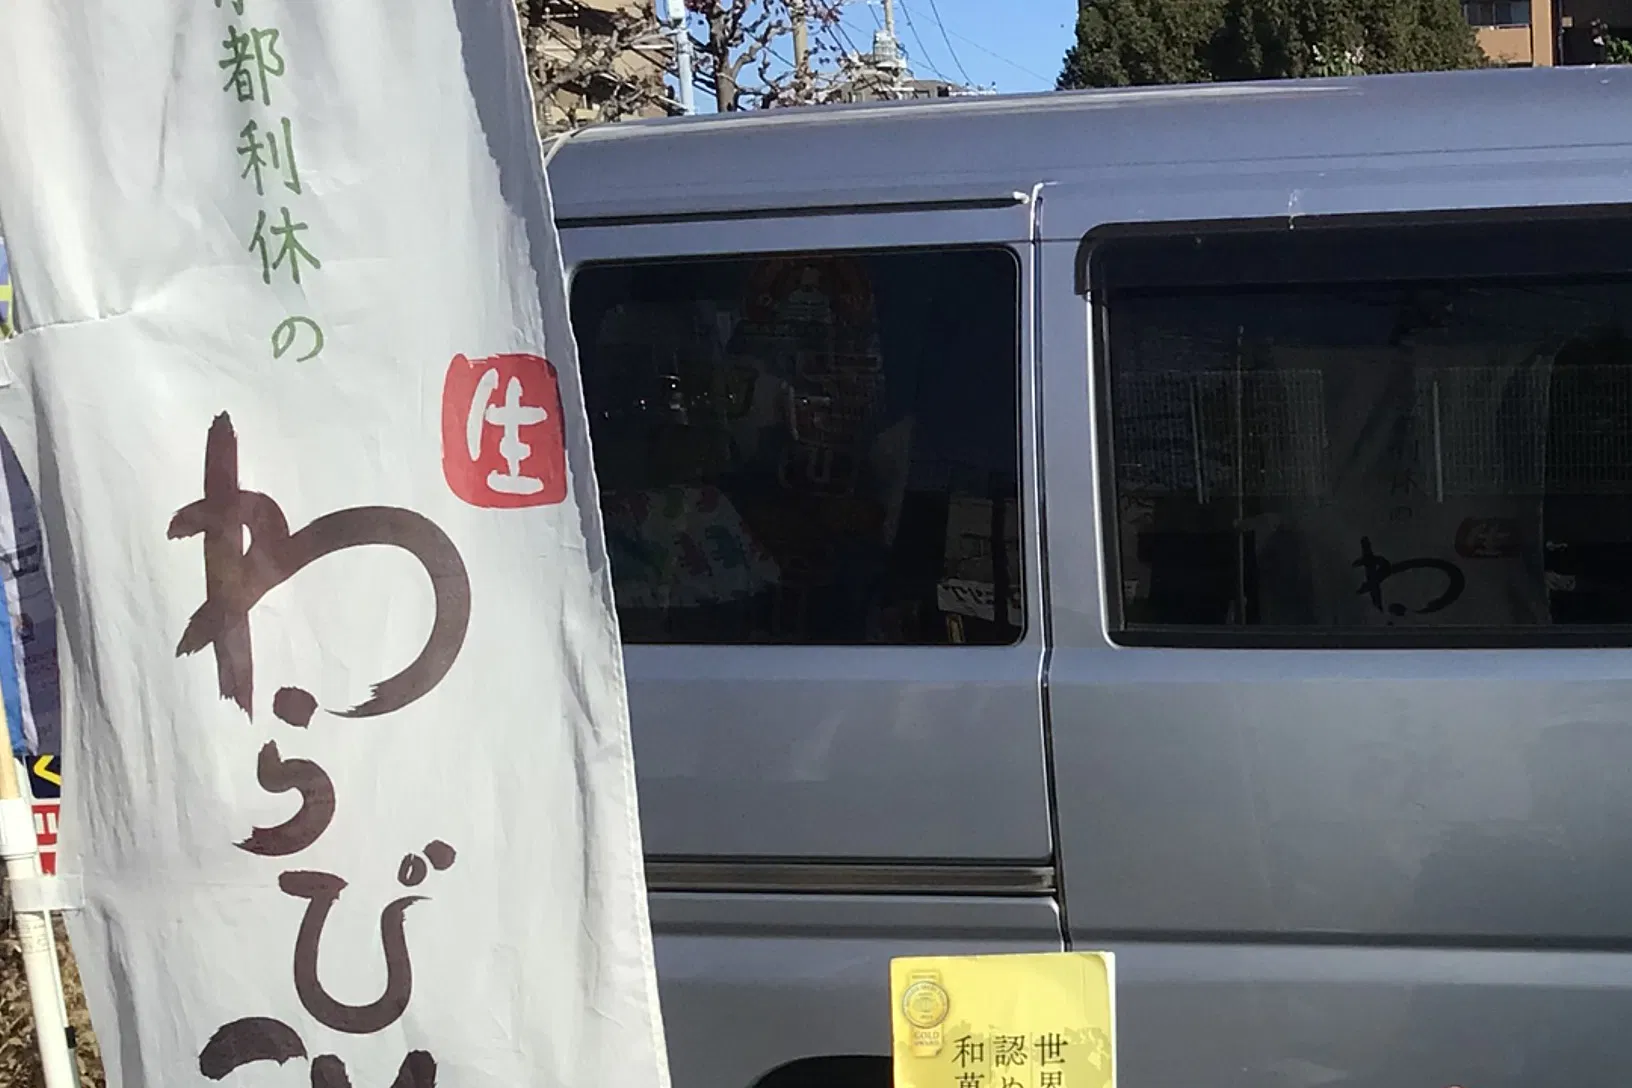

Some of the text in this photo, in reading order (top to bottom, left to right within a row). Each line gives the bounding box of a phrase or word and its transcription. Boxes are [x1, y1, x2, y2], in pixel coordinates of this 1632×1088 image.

[214, 0, 324, 363] 都利休の
[463, 365, 550, 496] 生
